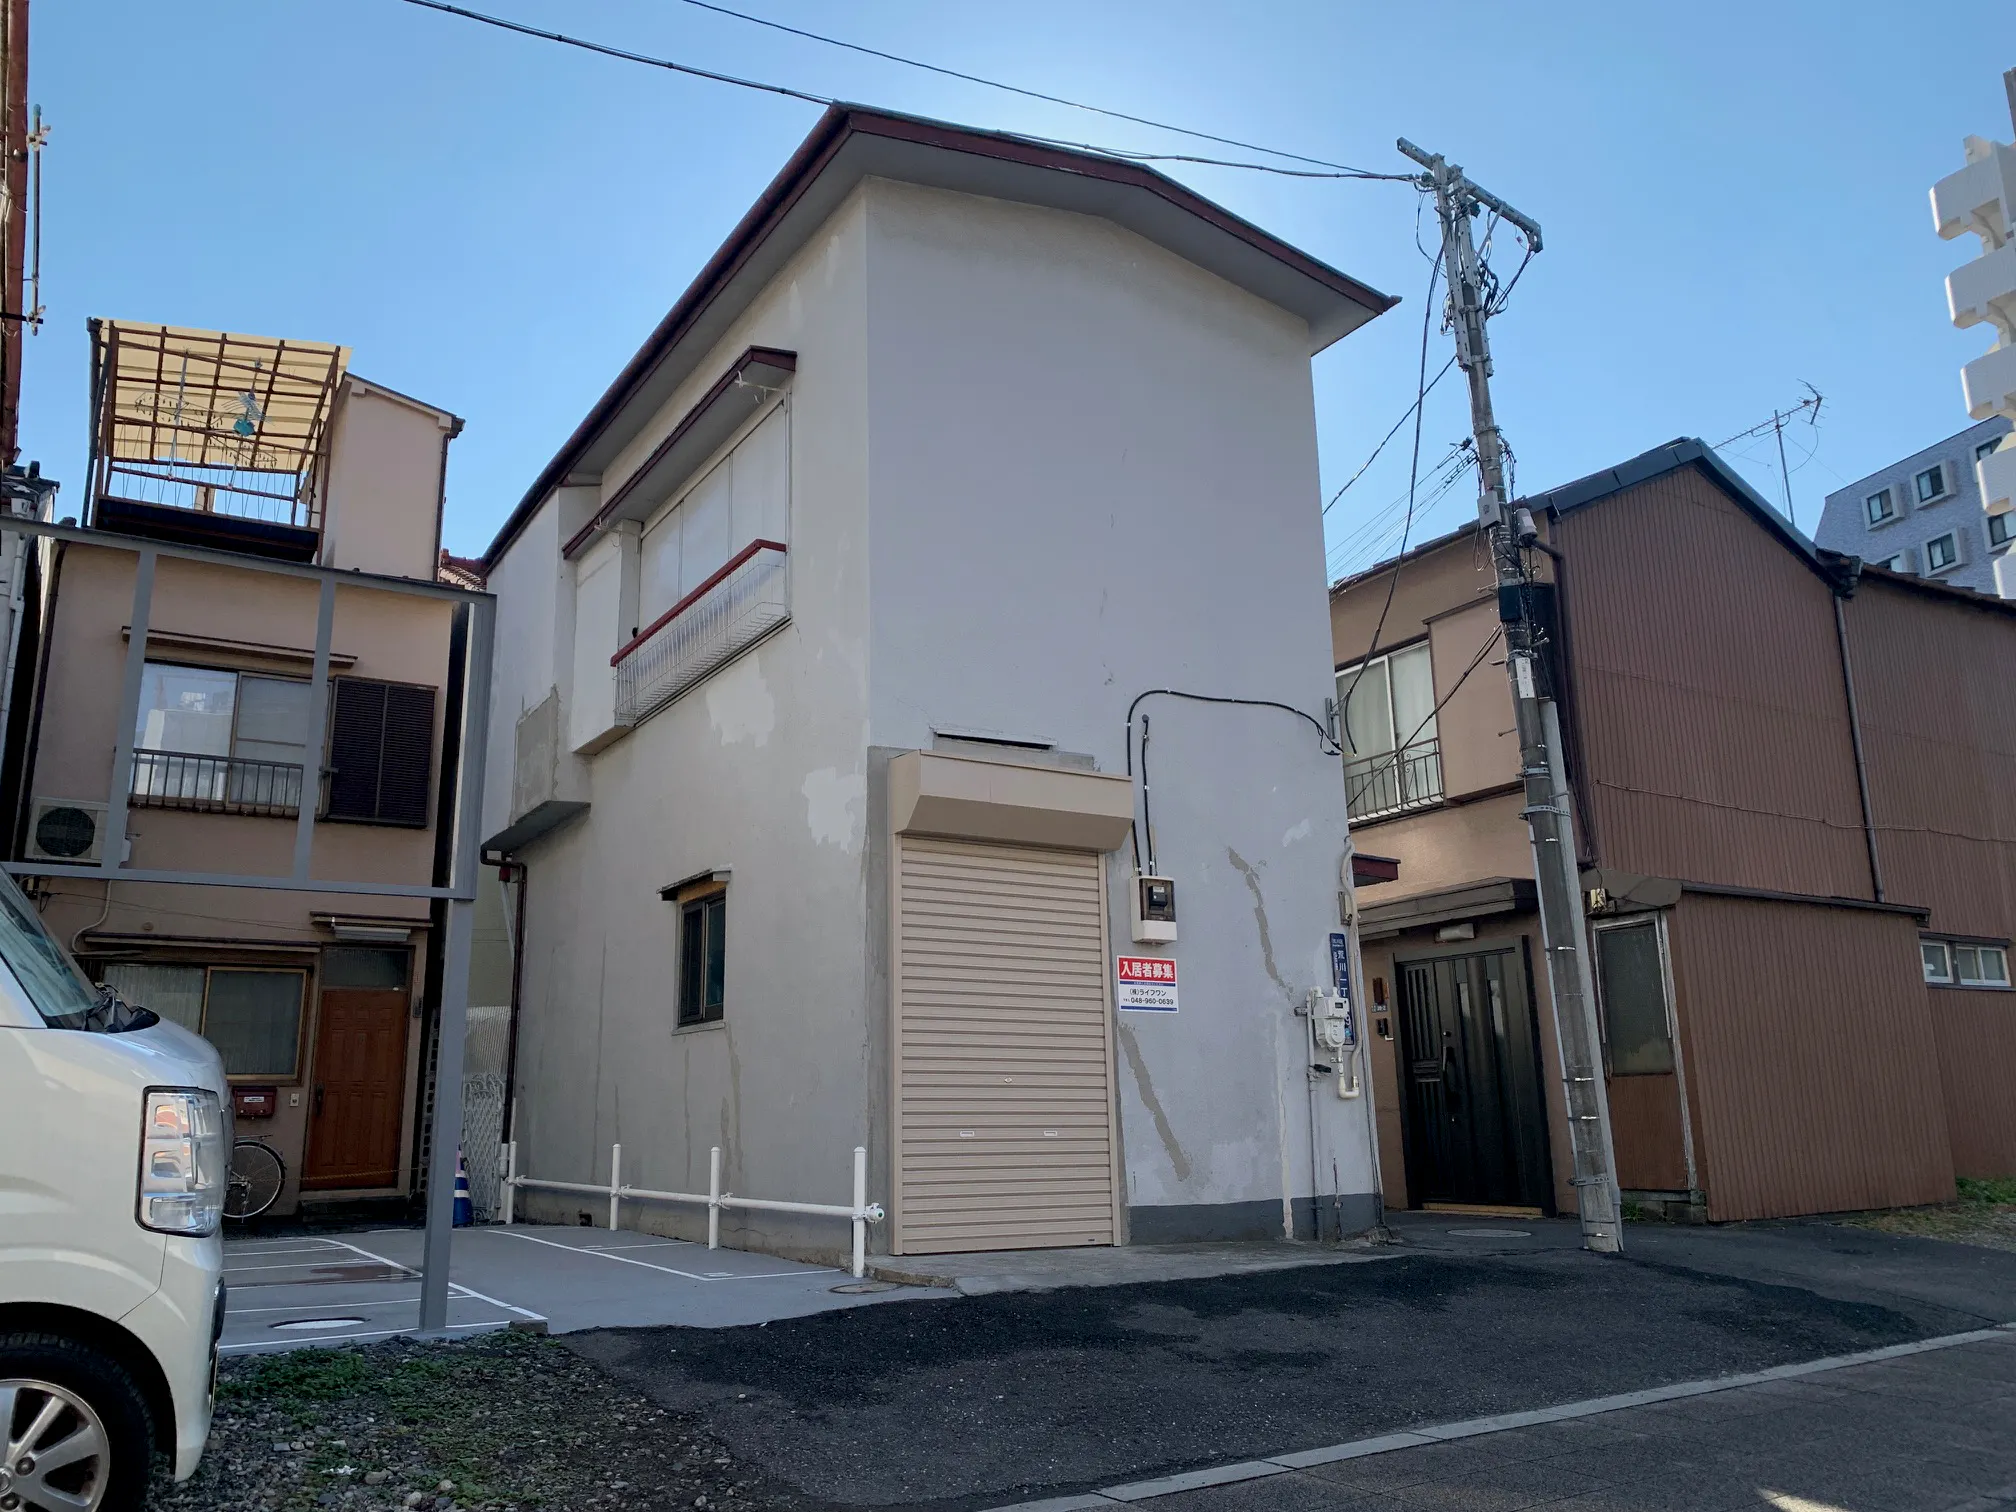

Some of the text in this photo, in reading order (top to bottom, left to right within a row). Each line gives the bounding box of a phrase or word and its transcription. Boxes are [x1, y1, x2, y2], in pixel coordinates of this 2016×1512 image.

[1121, 961, 1173, 978] 入居者募集
